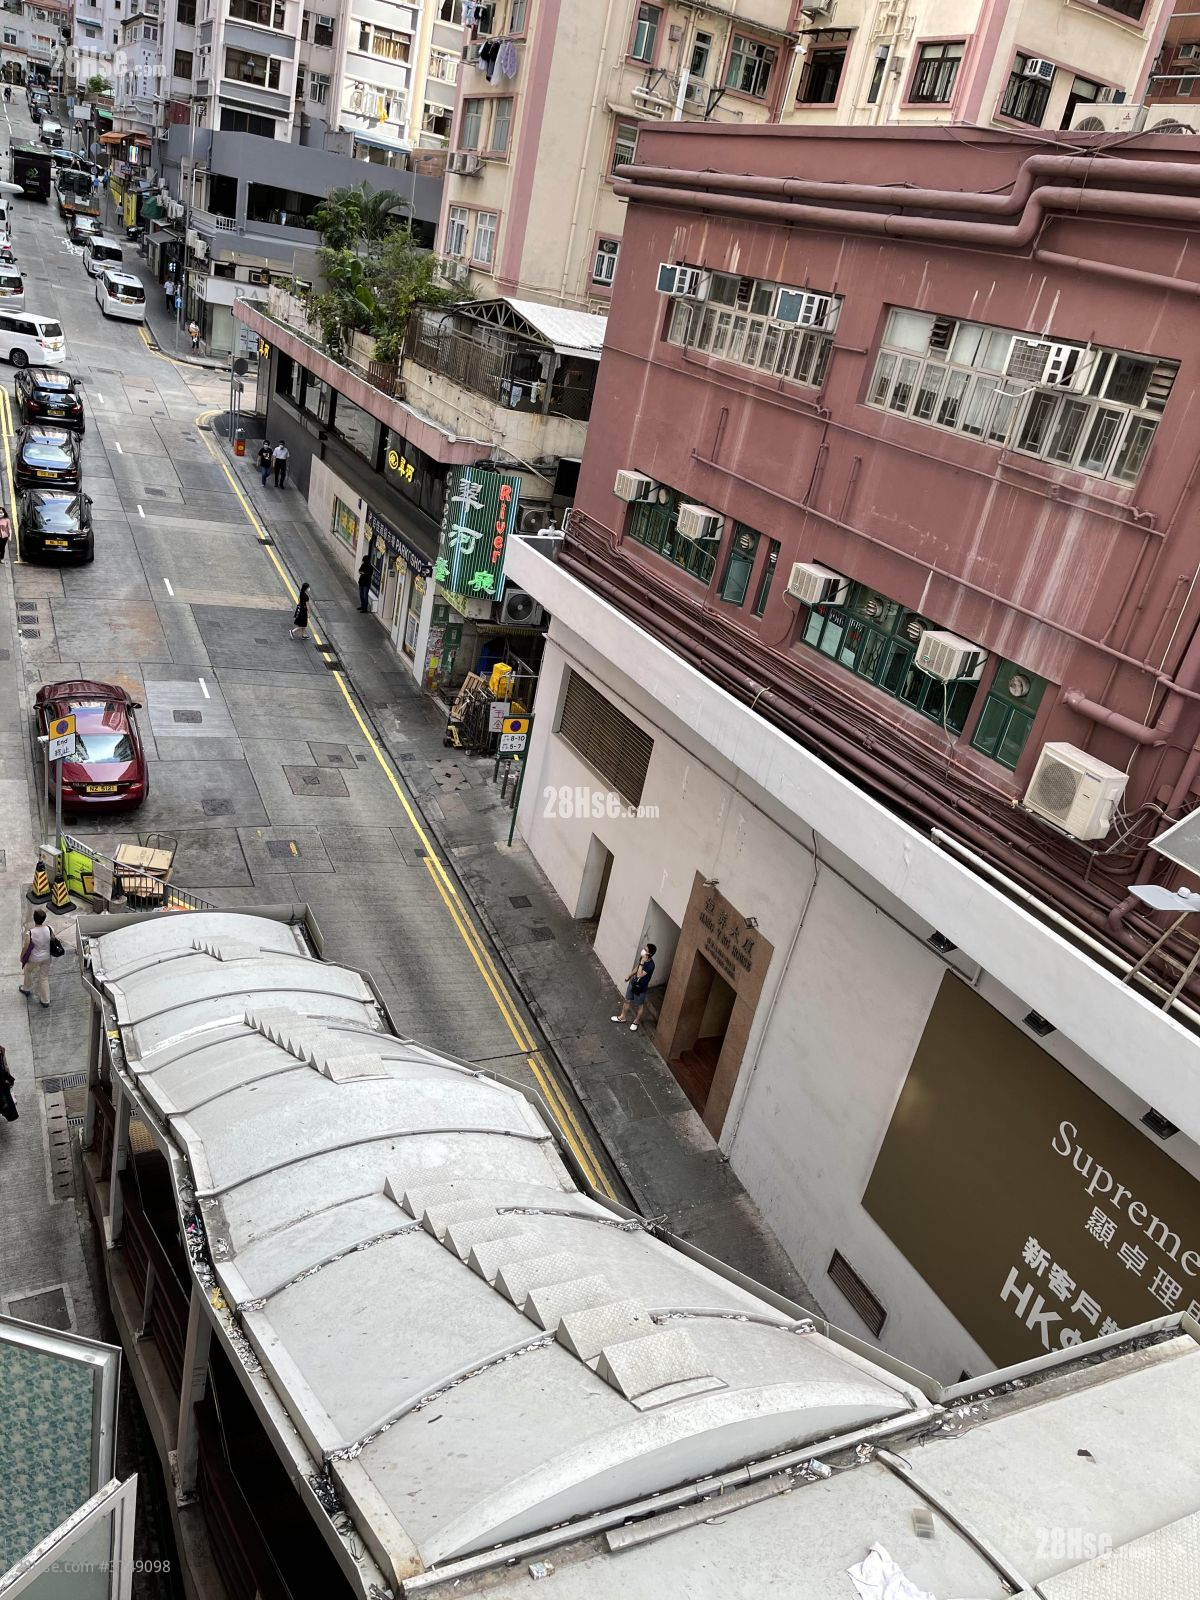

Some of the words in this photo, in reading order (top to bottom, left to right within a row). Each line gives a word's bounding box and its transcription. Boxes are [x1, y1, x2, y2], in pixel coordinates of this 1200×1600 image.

[447, 477, 485, 555] 翠河
[491, 484, 512, 564] River
[56, 738, 68, 746] End
[1052, 1121, 1200, 1277] Supreme
